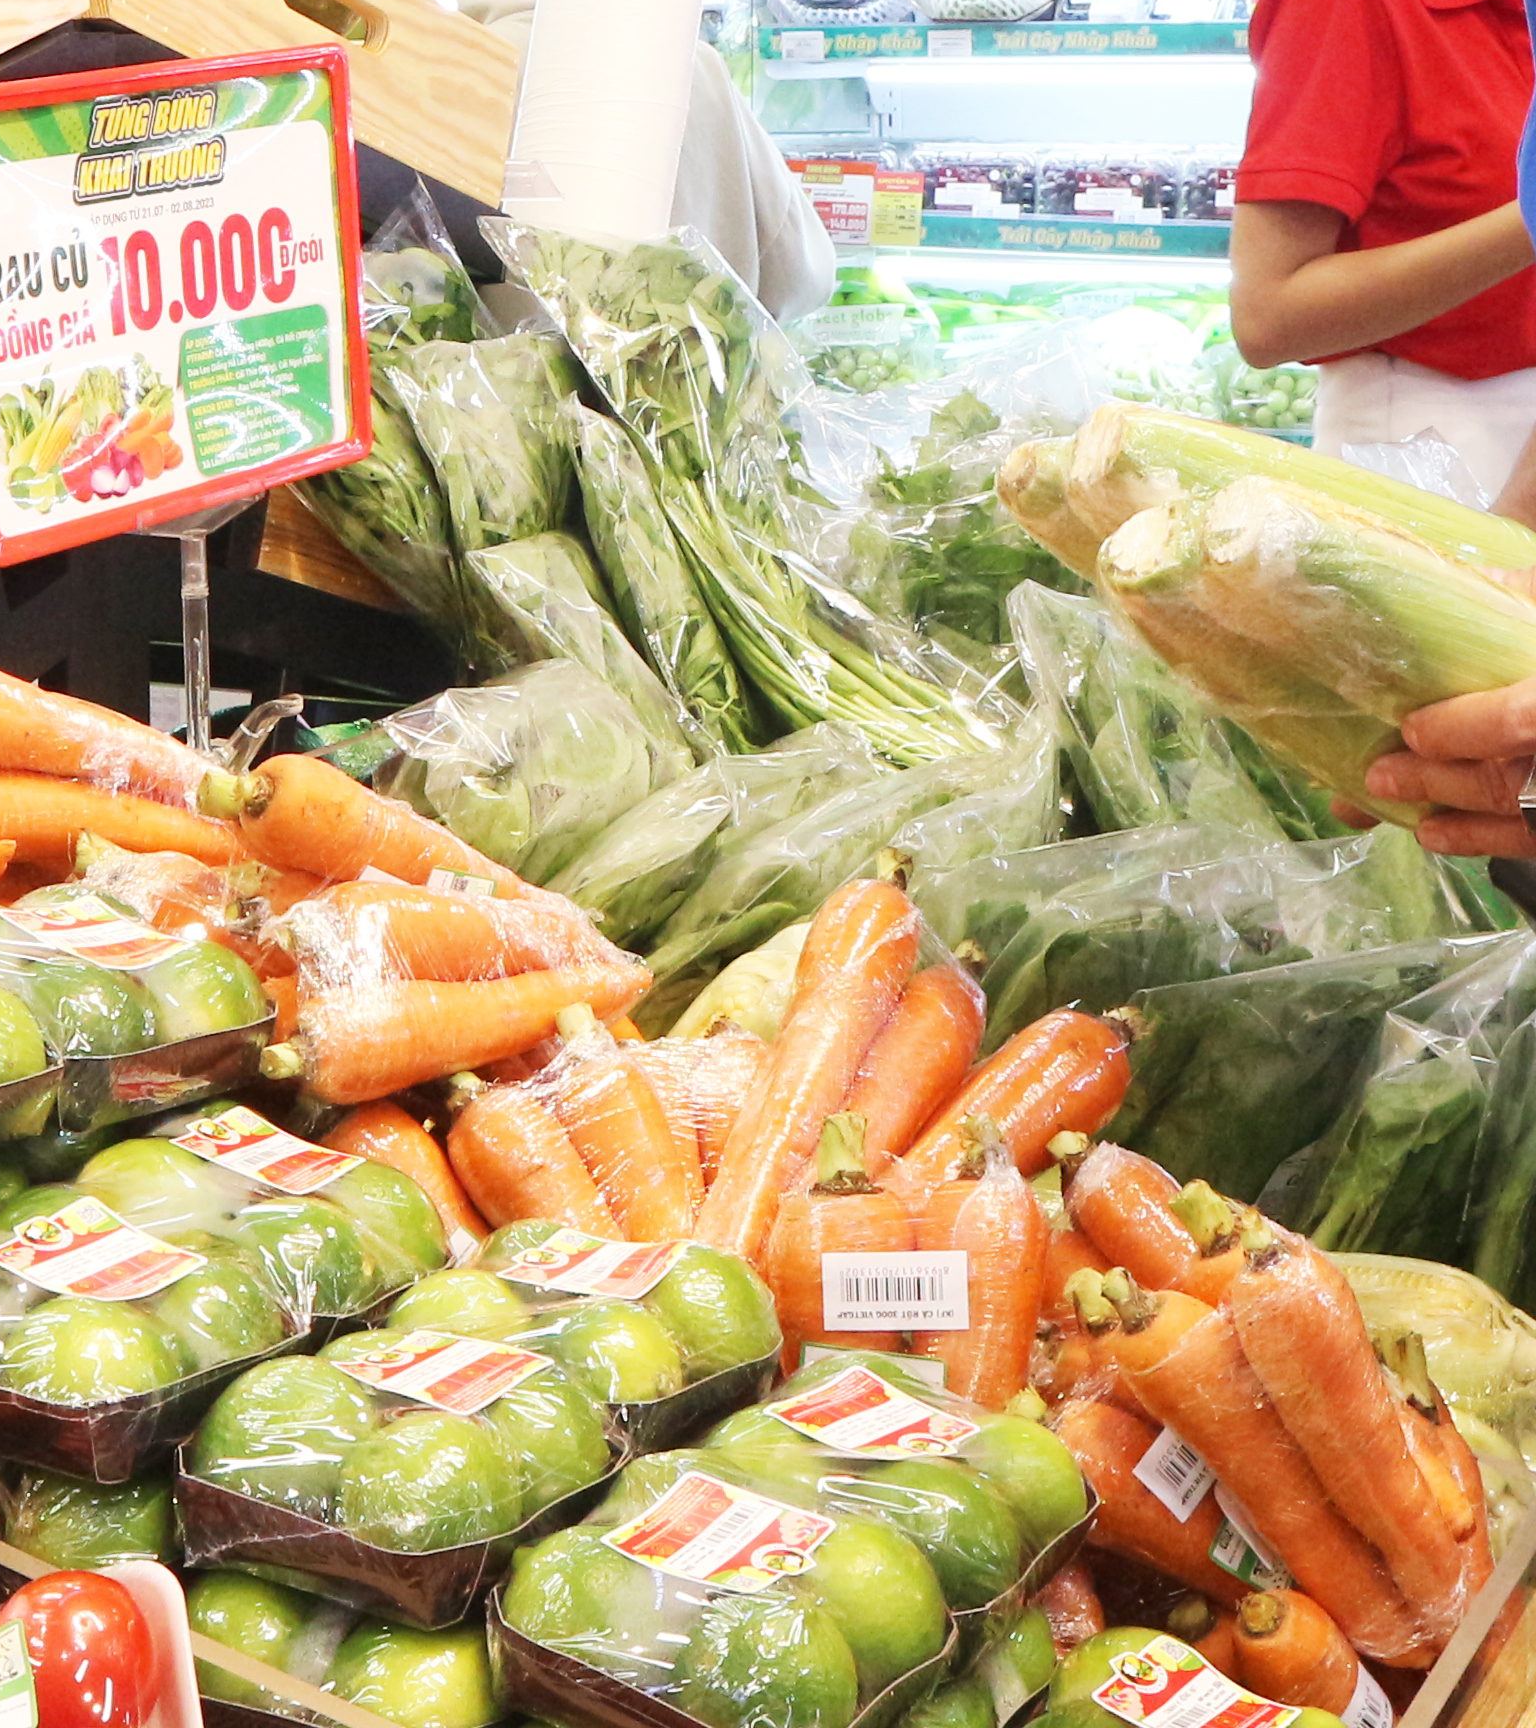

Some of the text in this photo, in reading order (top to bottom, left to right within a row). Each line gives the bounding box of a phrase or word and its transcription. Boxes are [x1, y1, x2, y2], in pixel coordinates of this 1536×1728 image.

[93, 92, 214, 144] TƯNG BỪNG
[79, 154, 133, 197] KHAI
[142, 205, 164, 219] 21.07
[170, 197, 215, 214] 02.08.2023
[54, 227, 89, 289] CỦ
[279, 231, 324, 271] Đ/GÓI
[59, 300, 96, 352] GIÁ
